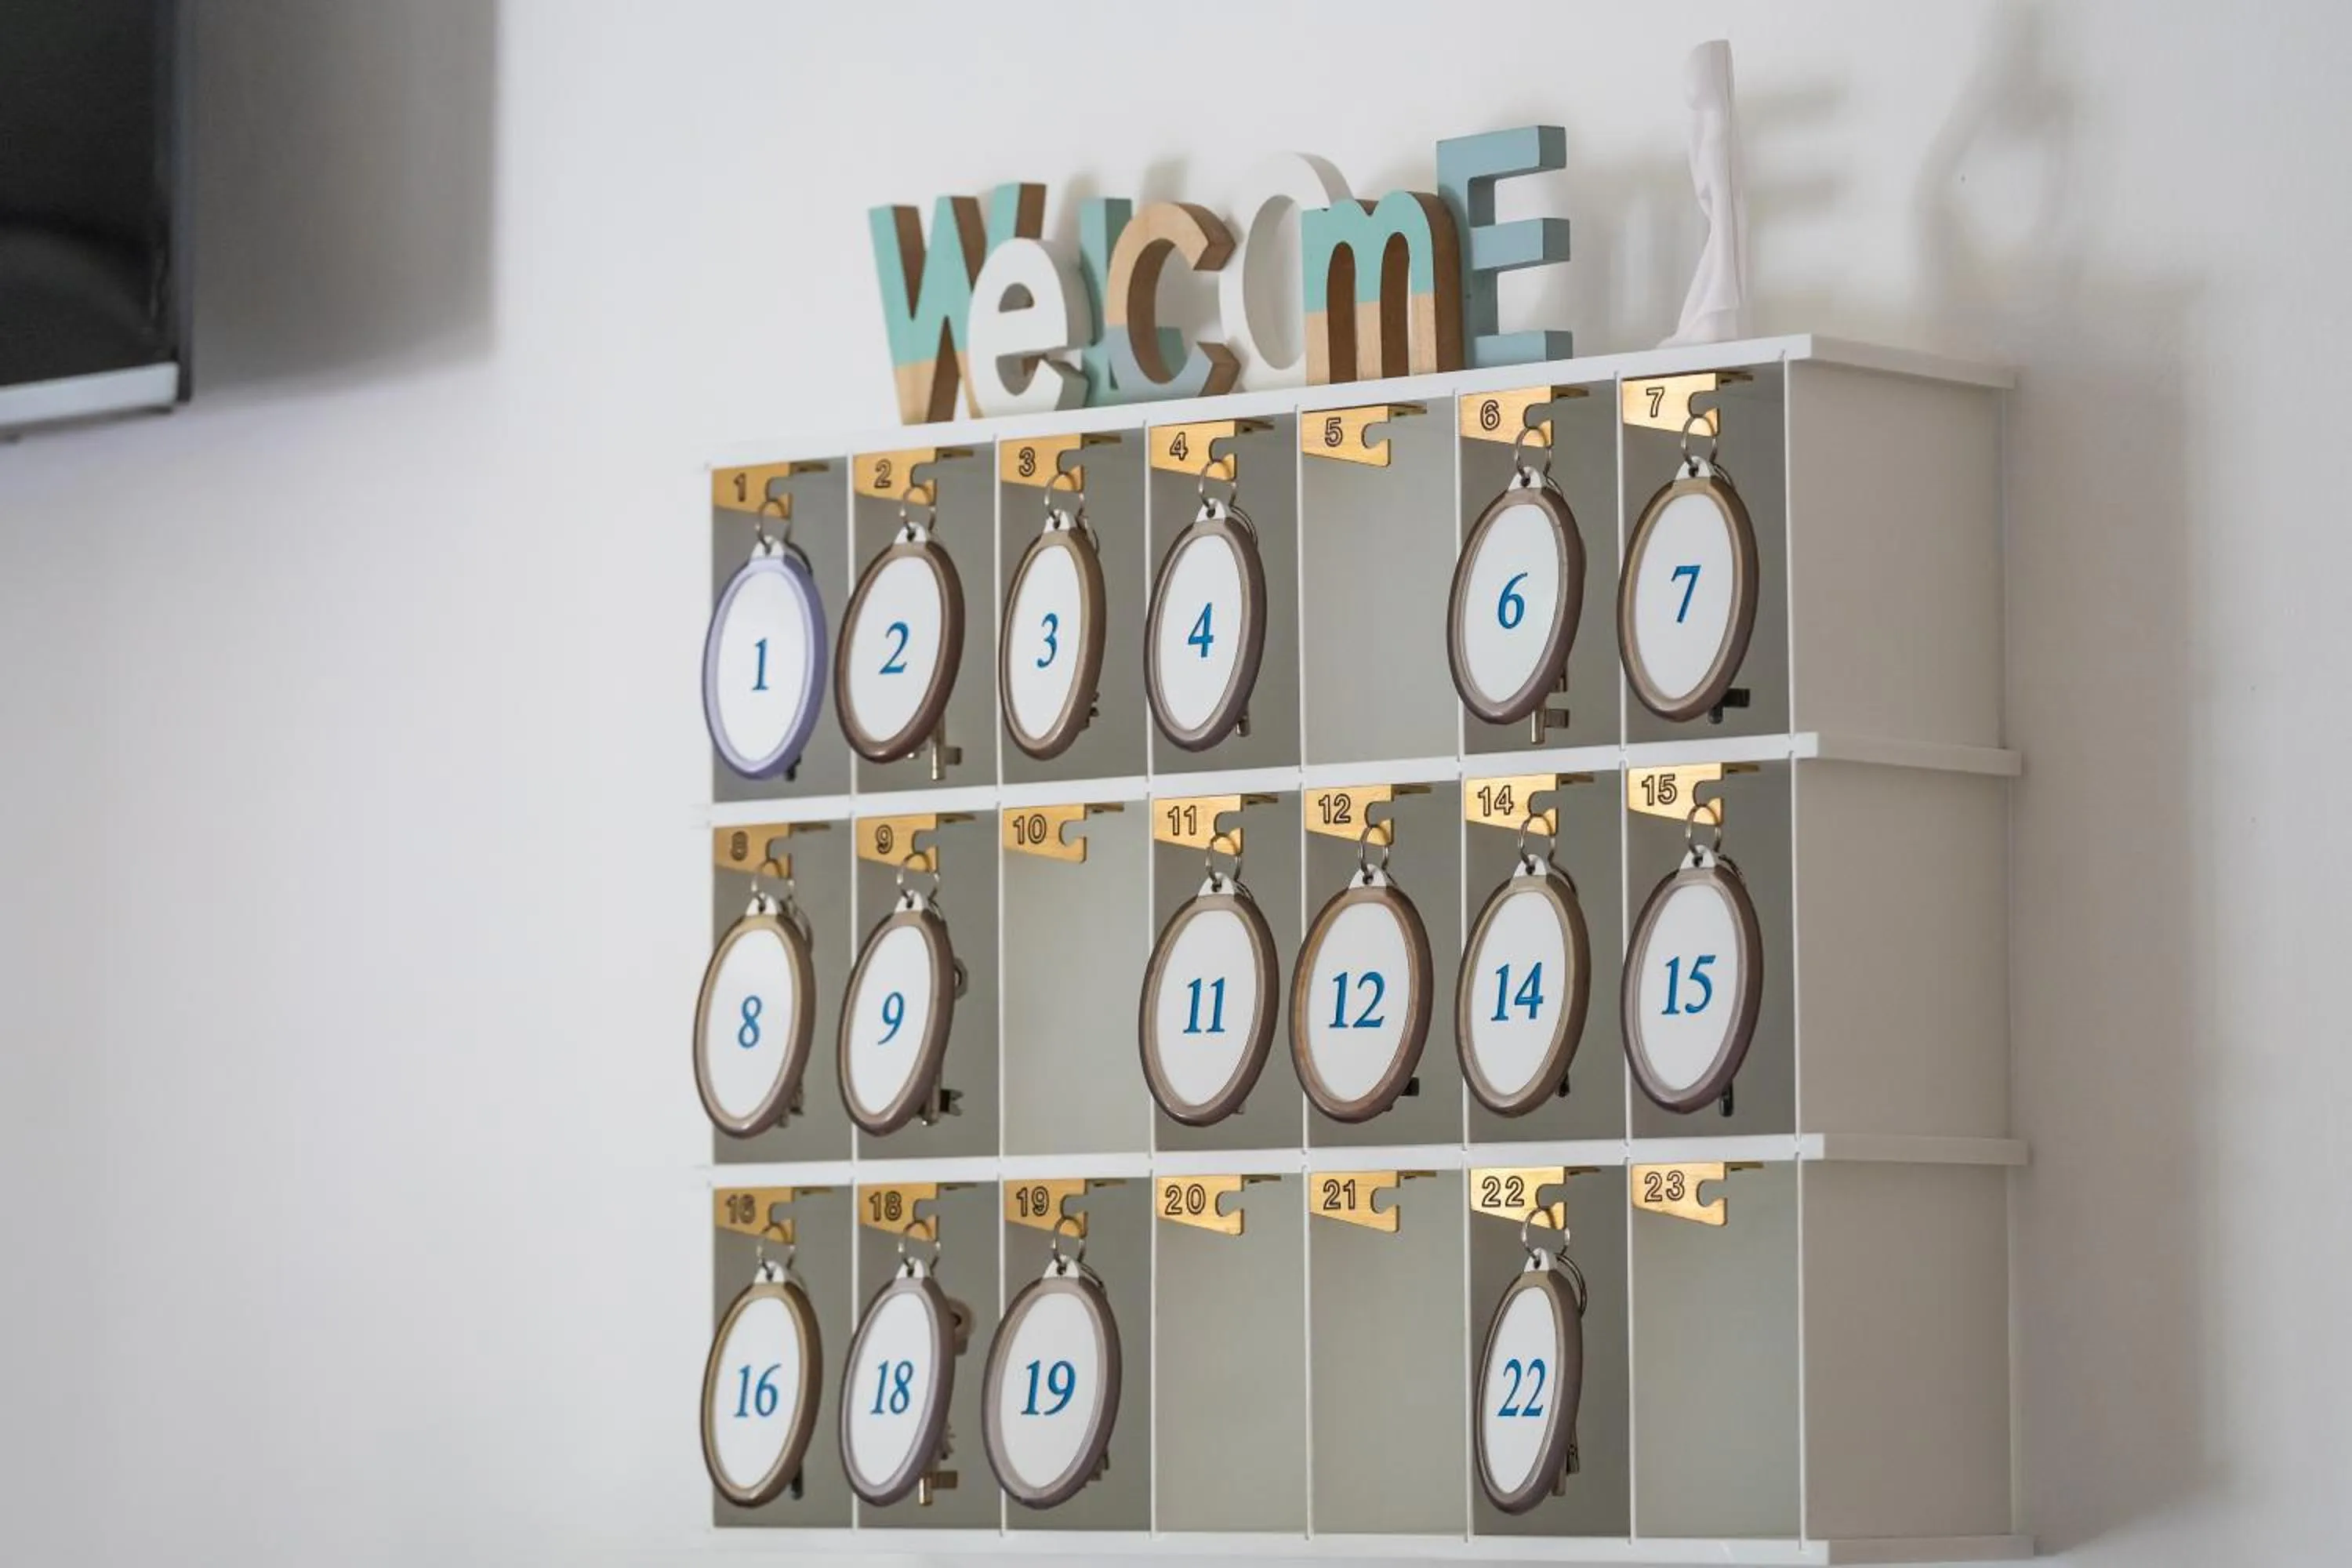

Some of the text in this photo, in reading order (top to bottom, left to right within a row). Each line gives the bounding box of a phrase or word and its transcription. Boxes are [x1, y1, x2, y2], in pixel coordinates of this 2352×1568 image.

[1480, 400, 1501, 430] 6
[1646, 387, 1664, 418] 7
[1170, 432, 1189, 461] 4
[1325, 417, 1343, 447] 5
[874, 459, 891, 489] 2
[1018, 447, 1036, 477] 3
[734, 473, 746, 503] 1
[1497, 572, 1527, 629] 6
[1671, 564, 1701, 623] 7
[1037, 613, 1058, 668] 3
[1188, 603, 1214, 658] 4
[880, 622, 909, 674] 2
[753, 639, 768, 691] 1
[1478, 786, 1514, 817] 14
[1642, 774, 1677, 806] 15
[1167, 805, 1196, 836] 11
[1319, 793, 1351, 824] 12
[876, 825, 893, 855] 9
[1013, 814, 1047, 845] 10
[730, 831, 747, 862] 8
[1330, 972, 1385, 1028] 12
[1491, 962, 1543, 1021] 14
[1662, 955, 1715, 1014] 15
[878, 992, 904, 1044] 9
[1183, 978, 1225, 1033] 11
[738, 996, 762, 1049] 8
[1016, 1186, 1049, 1217] 19
[1165, 1184, 1206, 1215] 20
[1323, 1179, 1355, 1210] 21
[1482, 1176, 1524, 1207] 22
[1645, 1171, 1685, 1203] 23
[869, 1191, 902, 1221] 18
[735, 1364, 780, 1417] 16
[872, 1361, 913, 1414] 18
[1022, 1360, 1076, 1415] 19
[1497, 1358, 1546, 1417] 22
